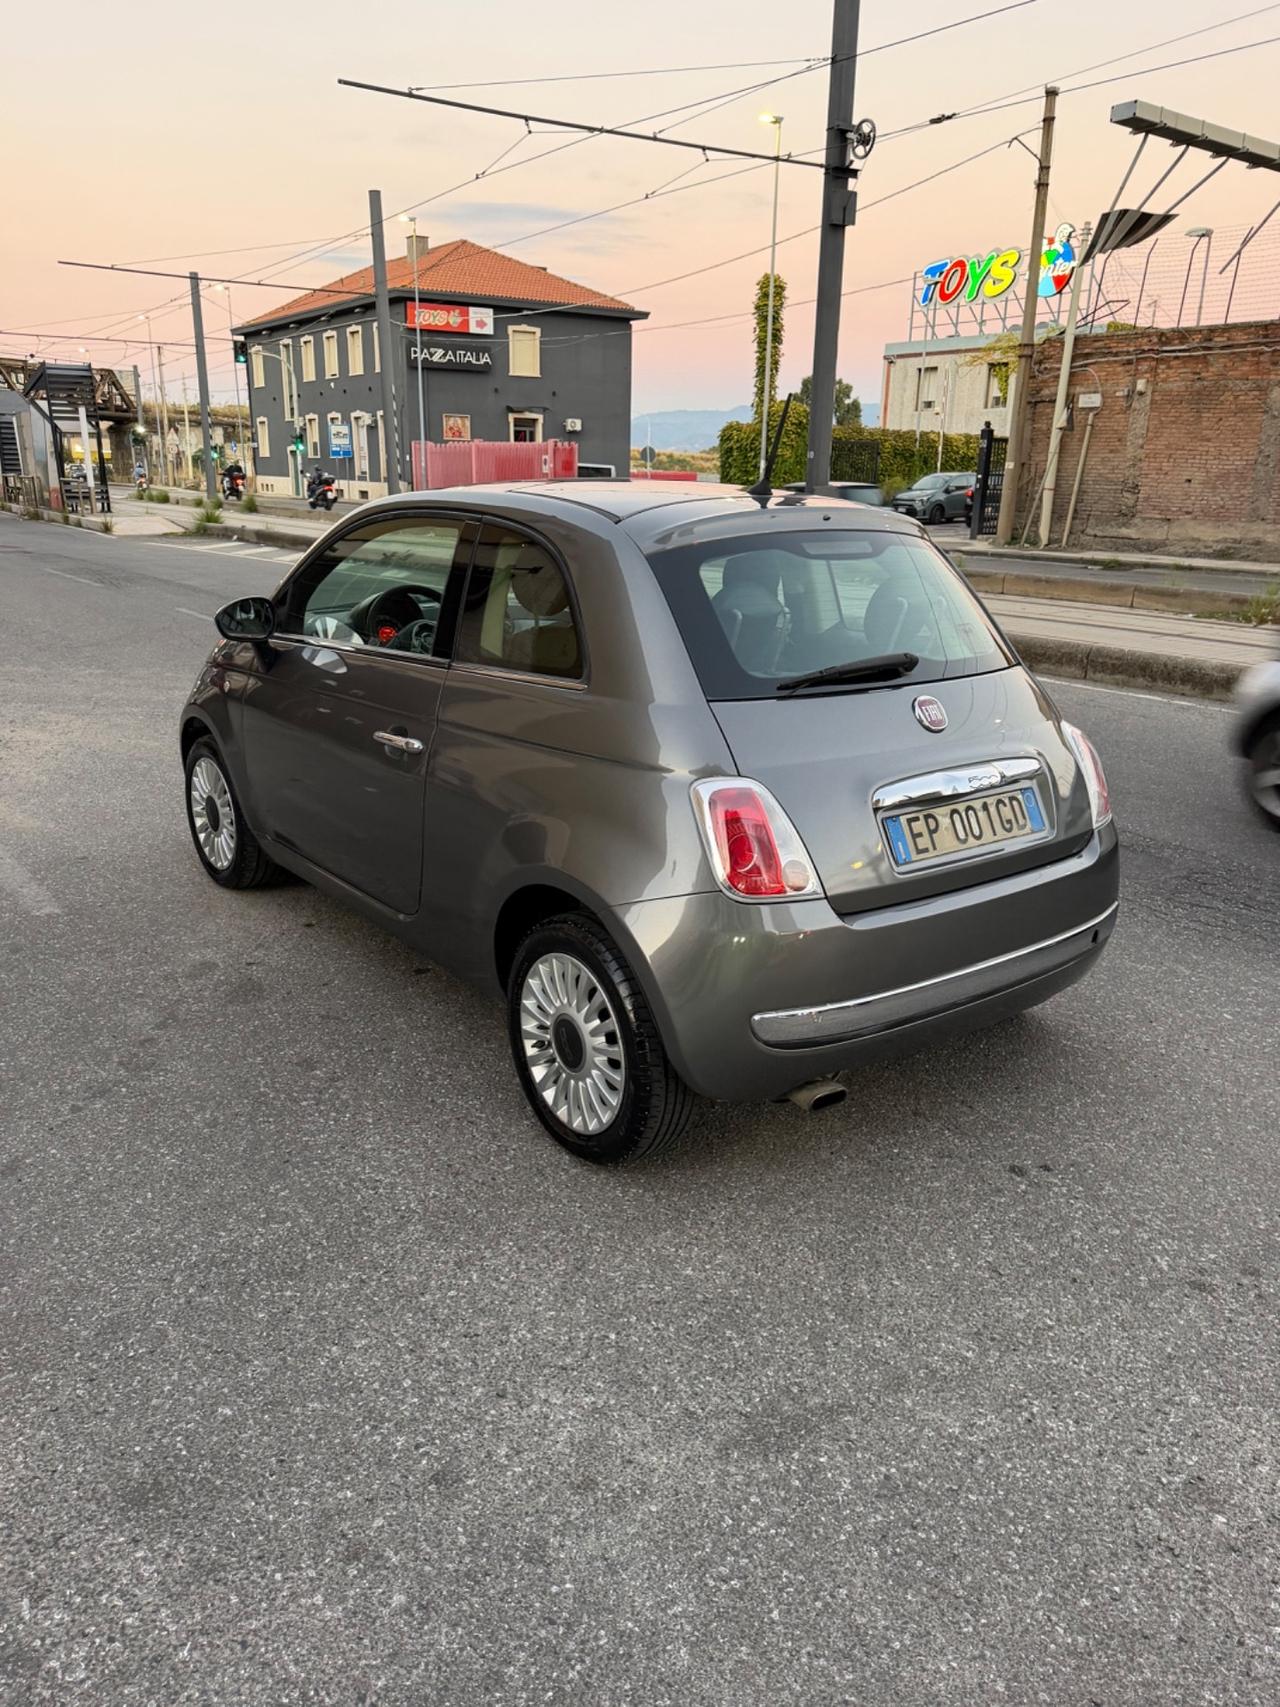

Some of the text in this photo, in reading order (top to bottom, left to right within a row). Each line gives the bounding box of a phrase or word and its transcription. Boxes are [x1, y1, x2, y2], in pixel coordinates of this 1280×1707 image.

[921, 249, 1020, 306] TOYS
[415, 308, 448, 326] TOYS
[410, 346, 455, 363] PAZZA
[921, 704, 944, 721] FIAT
[906, 812, 940, 856] EP
[949, 795, 1028, 845] 001GD
